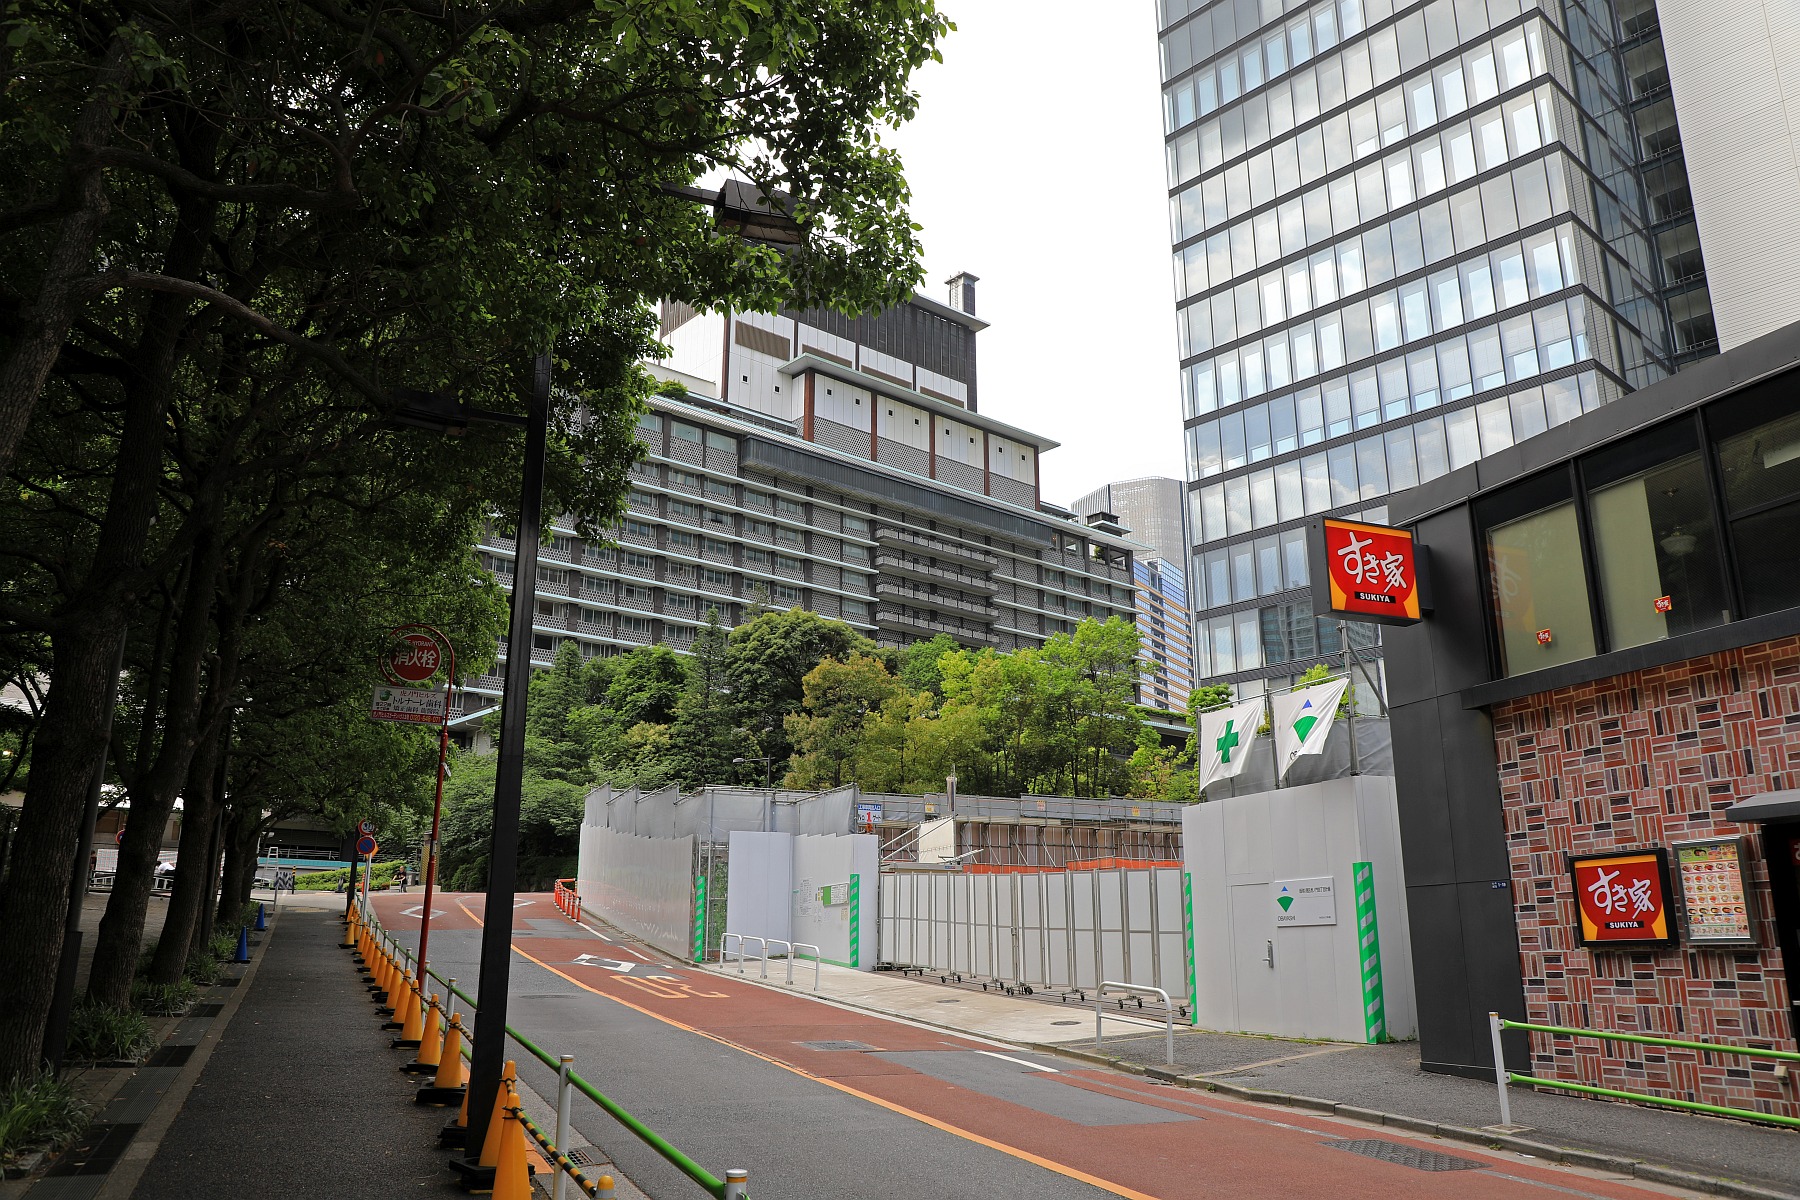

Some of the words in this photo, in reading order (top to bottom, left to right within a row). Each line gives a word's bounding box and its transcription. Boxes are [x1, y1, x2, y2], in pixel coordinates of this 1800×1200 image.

[1337, 531, 1407, 593] すき家
[1359, 592, 1391, 603] SUKIYA
[394, 648, 437, 668] 消火栓
[1587, 867, 1655, 919] すき家
[1609, 921, 1639, 929] SUKIYA
